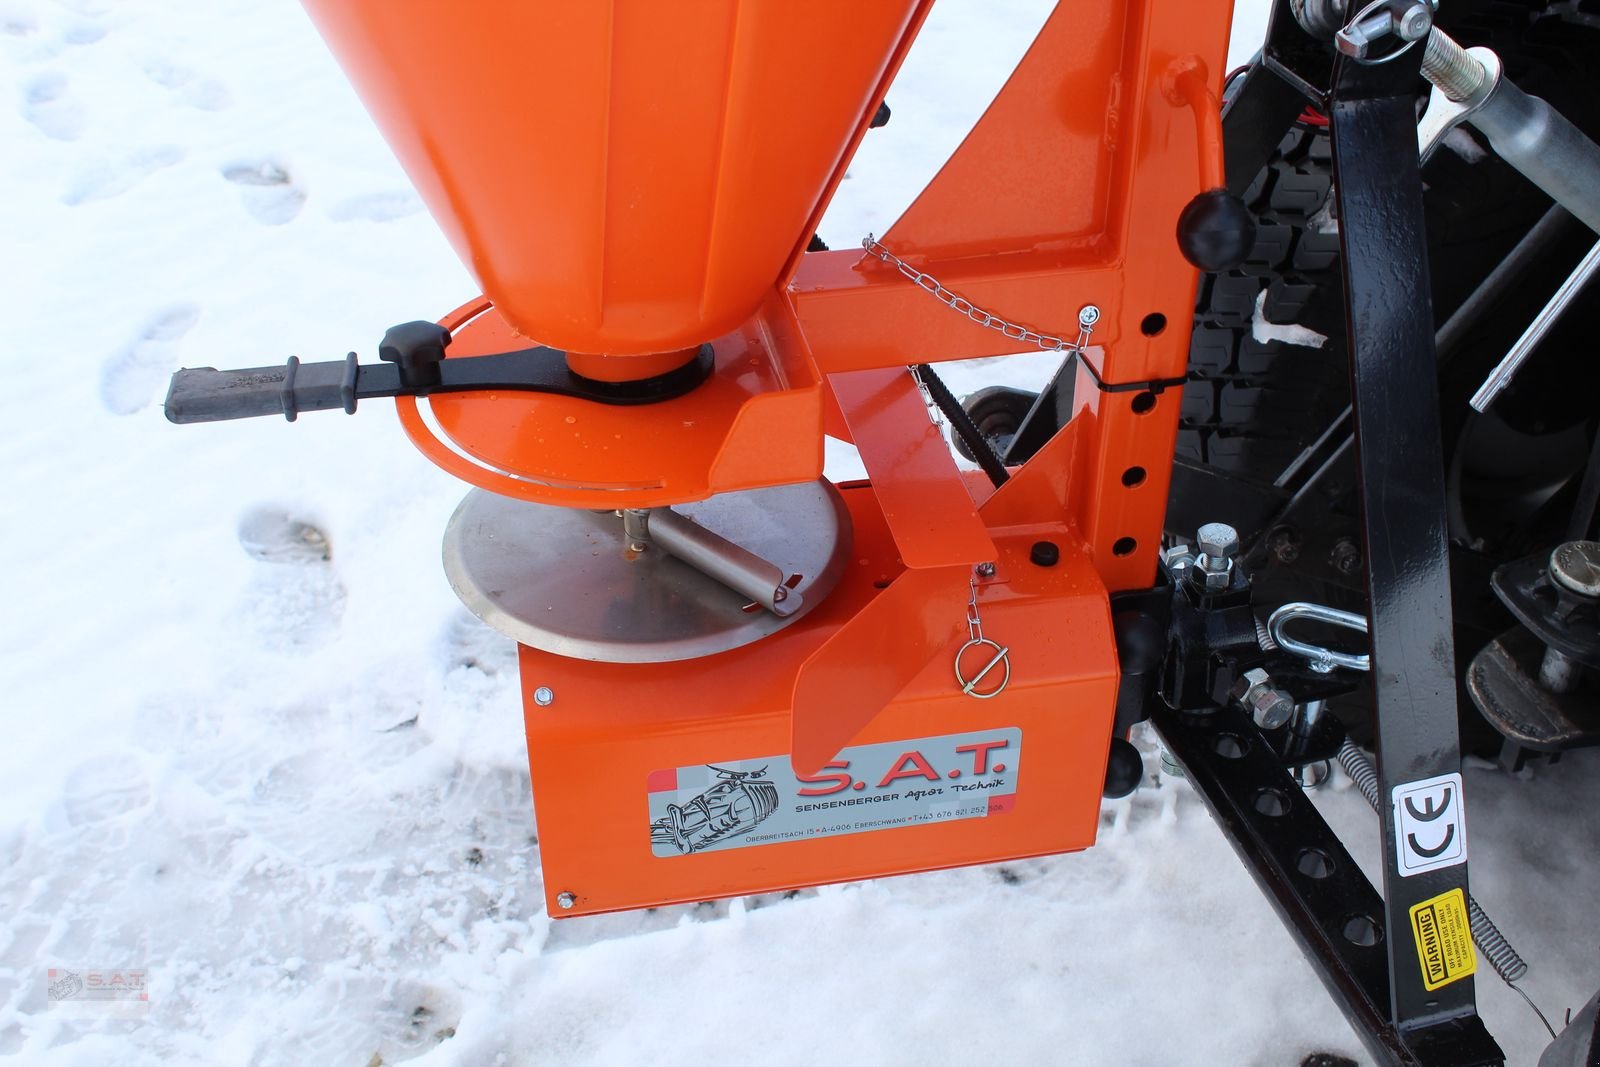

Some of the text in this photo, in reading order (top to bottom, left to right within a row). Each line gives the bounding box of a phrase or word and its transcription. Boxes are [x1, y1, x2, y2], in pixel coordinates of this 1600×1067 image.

[795, 794, 899, 813] SENSENBERGER
[951, 779, 1005, 792] Technik
[746, 831, 803, 843] OBERBREITSACH
[955, 808, 967, 816] 821
[970, 806, 985, 814] 252
[1405, 788, 1454, 858] CE
[1420, 913, 1442, 976] WARNING
[1454, 940, 1462, 967] MAXIMUM
